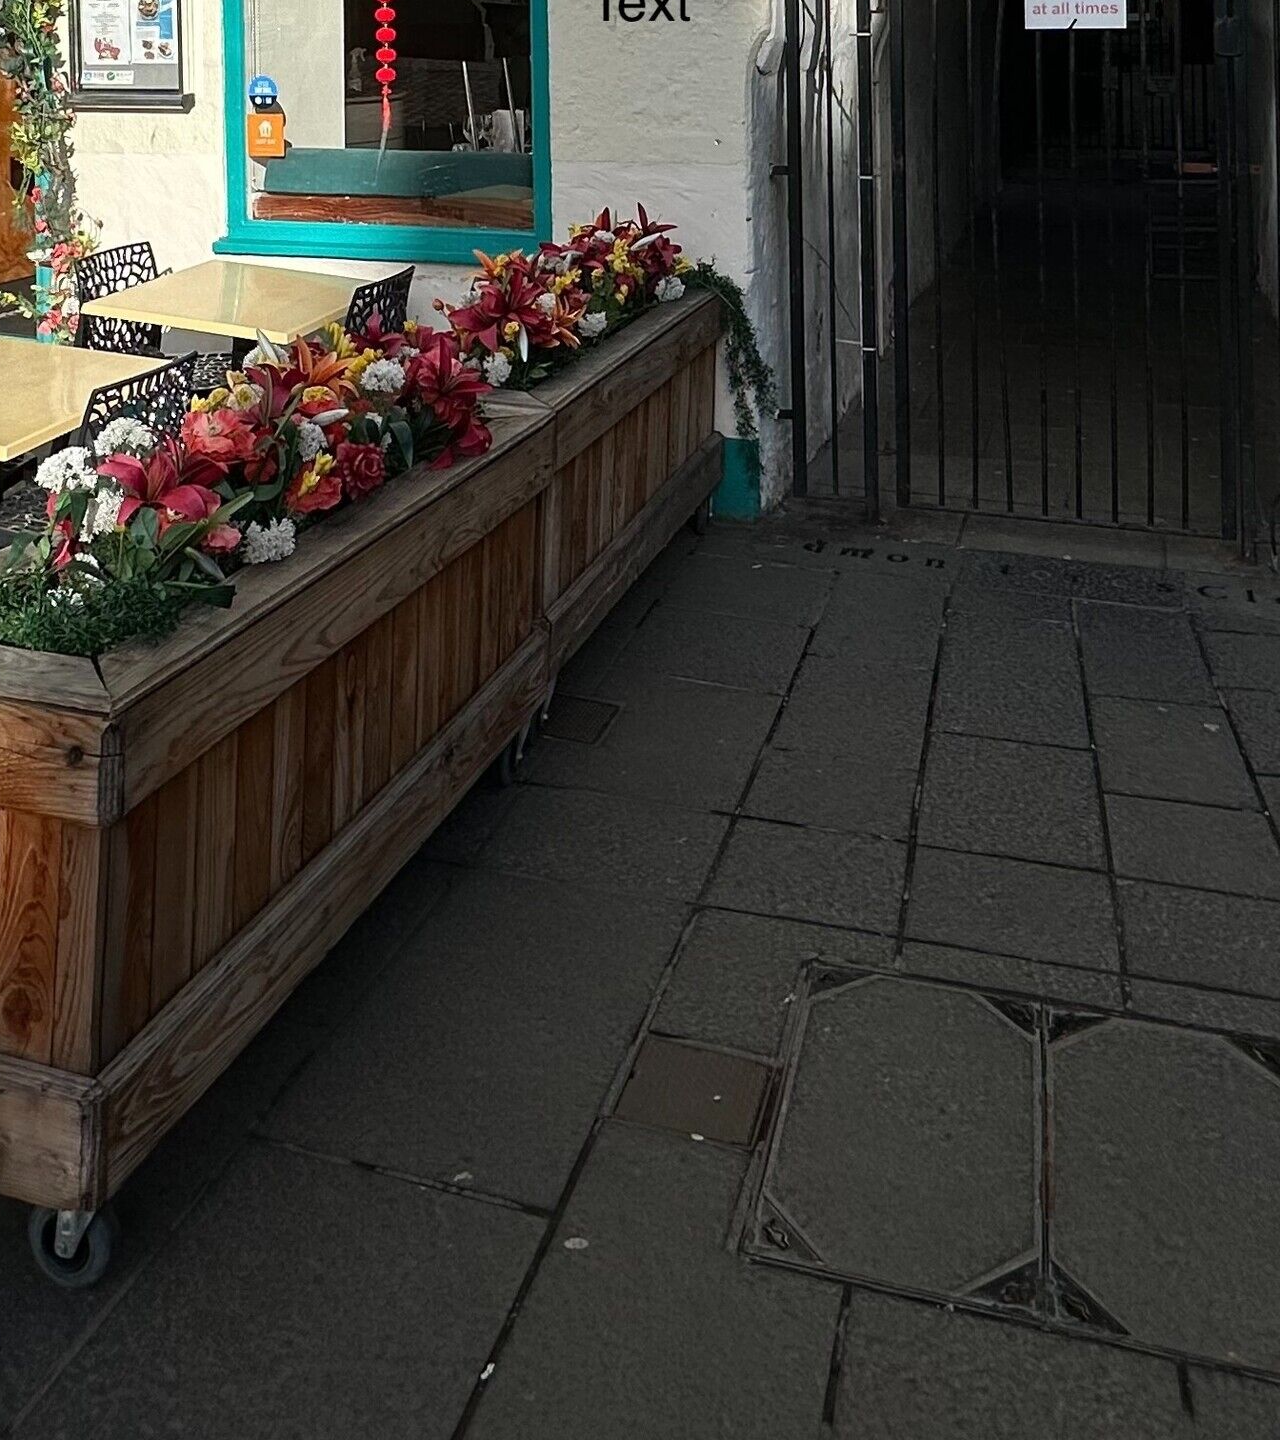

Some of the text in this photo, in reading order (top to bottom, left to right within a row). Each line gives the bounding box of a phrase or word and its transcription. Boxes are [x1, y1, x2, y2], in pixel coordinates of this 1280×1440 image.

[1032, 2, 1119, 15] at all times
